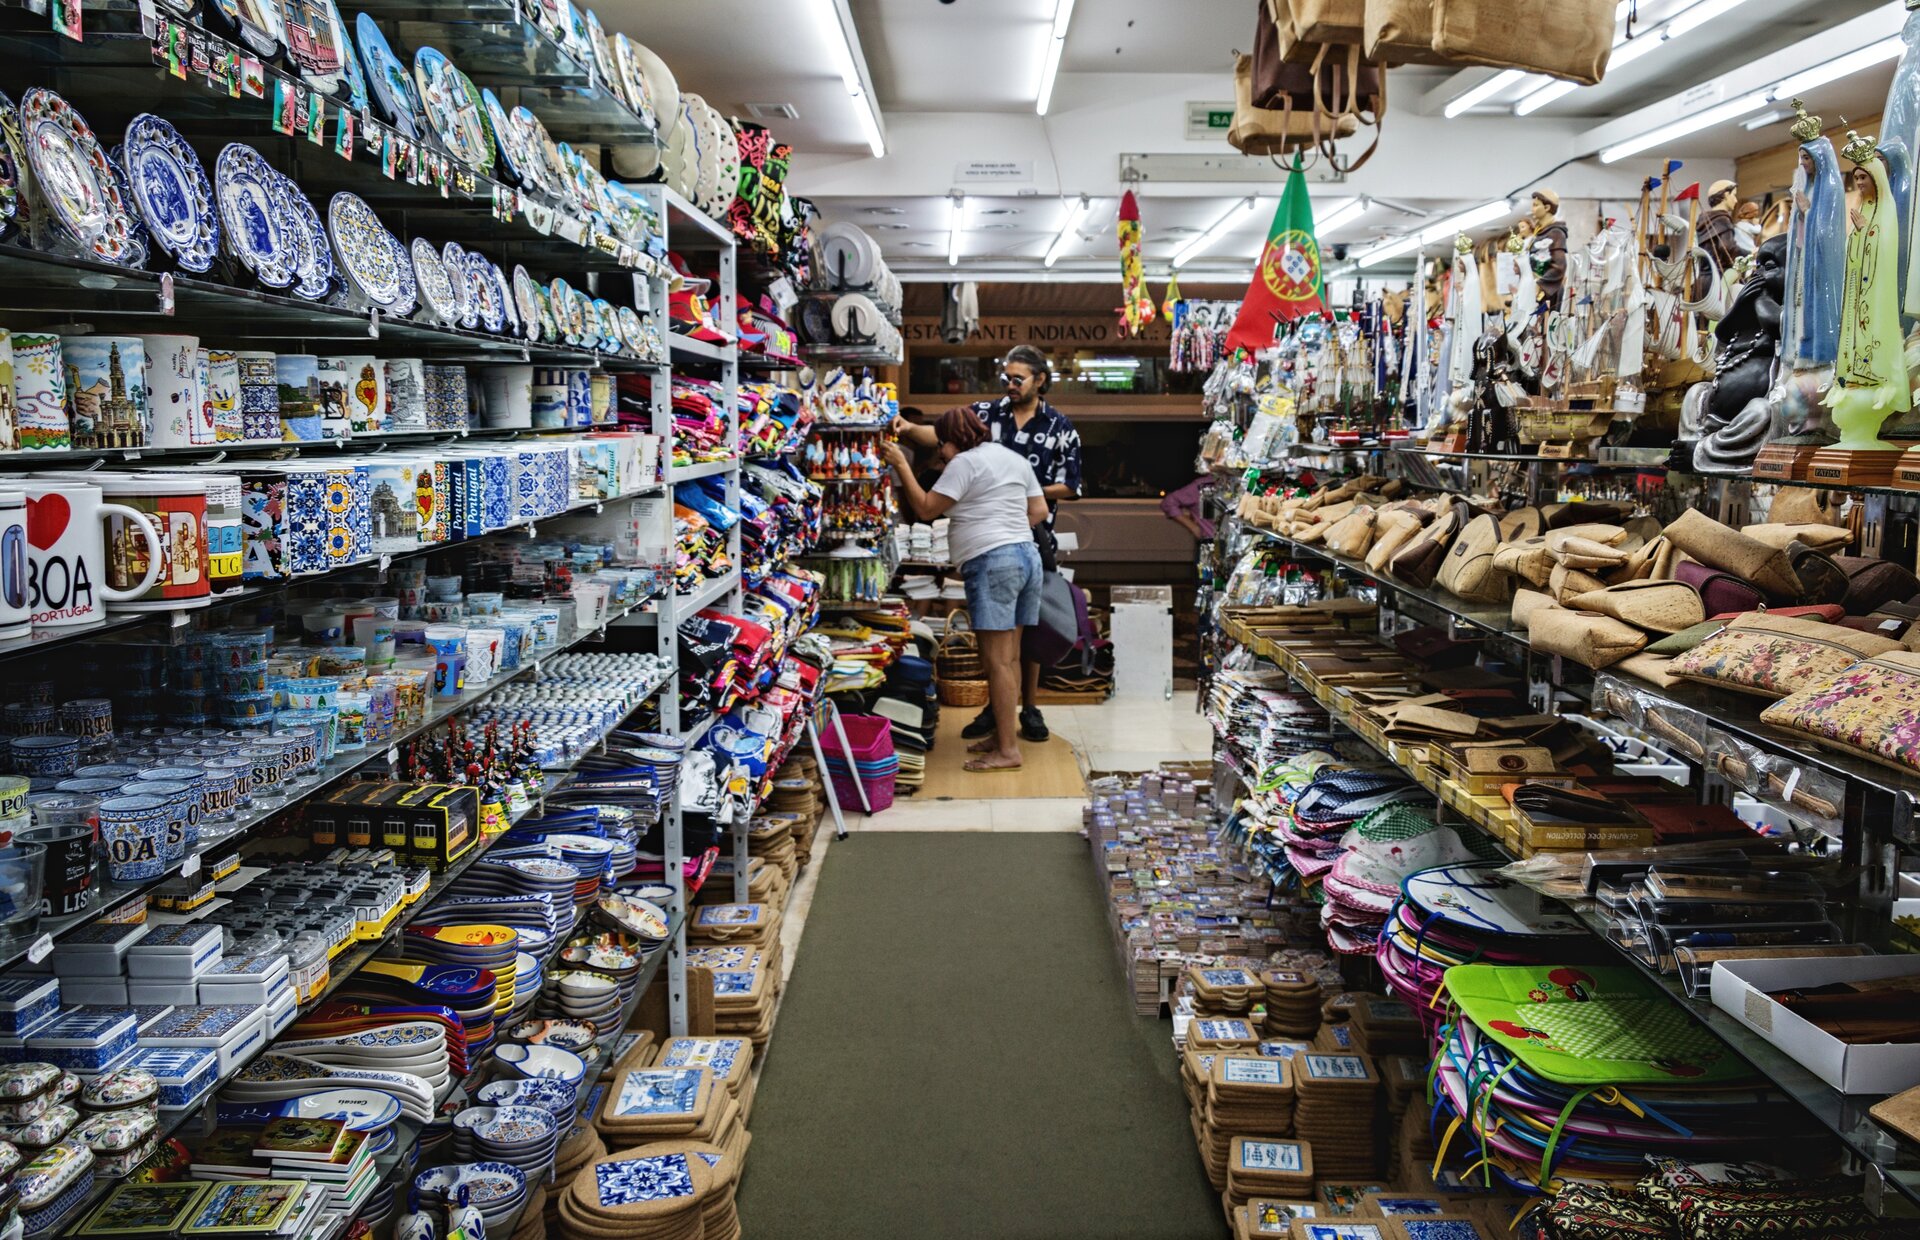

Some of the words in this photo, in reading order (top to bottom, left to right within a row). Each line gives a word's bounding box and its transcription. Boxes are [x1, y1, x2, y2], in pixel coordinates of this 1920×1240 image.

[1029, 325, 1107, 341] INDIANO
[605, 449, 615, 488] Portugal
[1815, 469, 1840, 477] FATIMA
[453, 472, 462, 530] Portugal
[467, 467, 478, 523] Portugal
[209, 557, 241, 577] TUG
[28, 555, 92, 609] BOA
[31, 605, 93, 624] PORTUGAL
[1546, 832, 1585, 840] COLLECTION
[1588, 832, 1605, 840] CORK
[1607, 833, 1639, 841] GENUINE
